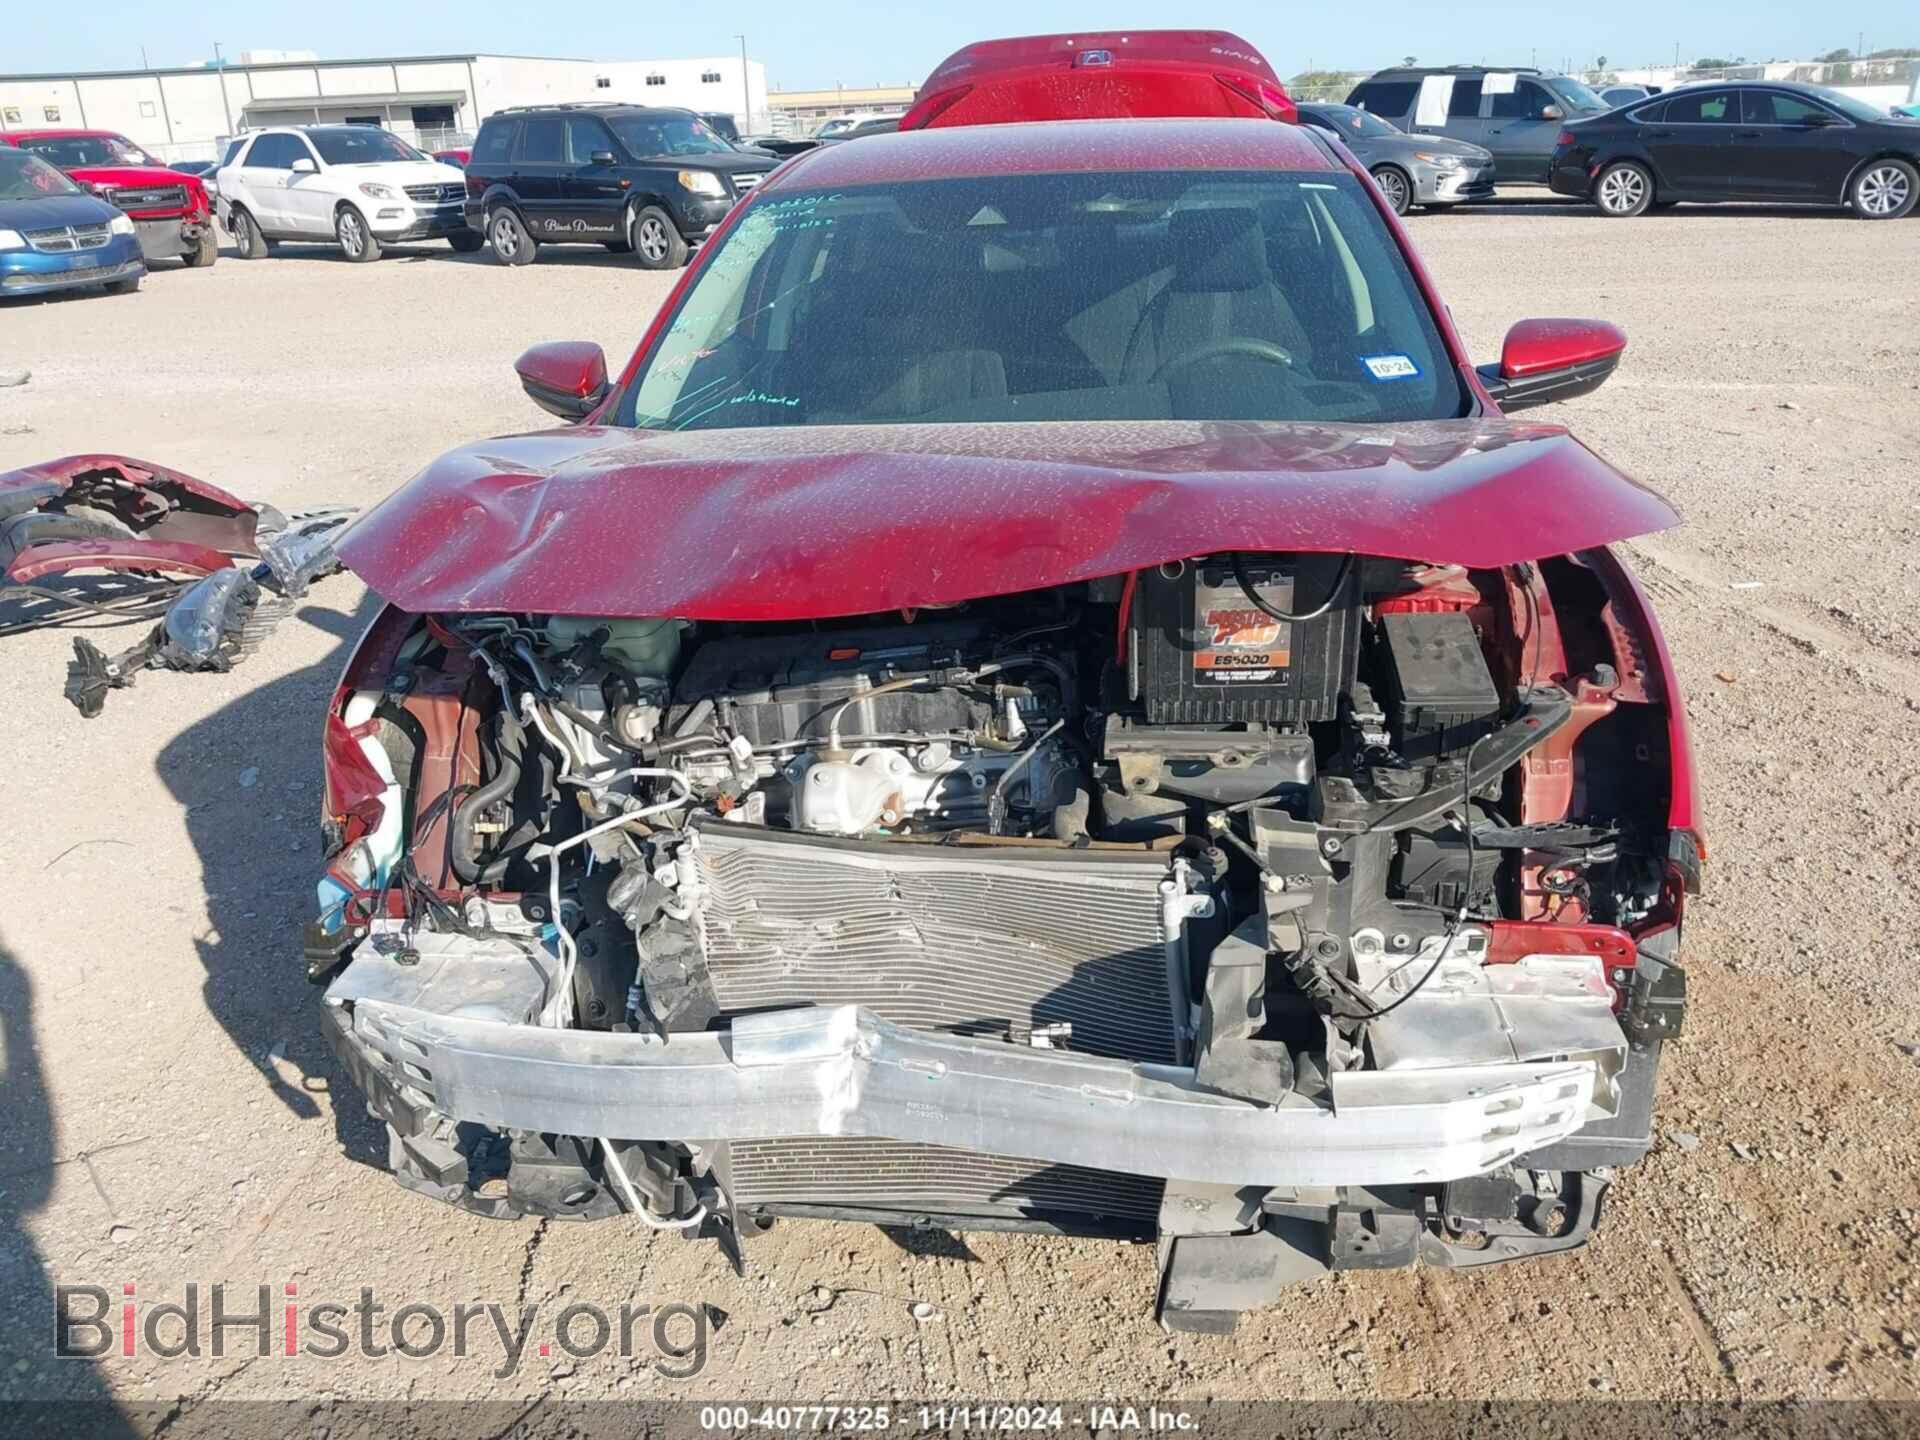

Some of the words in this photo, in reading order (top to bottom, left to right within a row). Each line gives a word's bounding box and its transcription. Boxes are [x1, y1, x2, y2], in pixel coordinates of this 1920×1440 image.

[544, 218, 571, 232] Black
[572, 218, 615, 232] Diamond
[1214, 654, 1270, 665] ES5000
